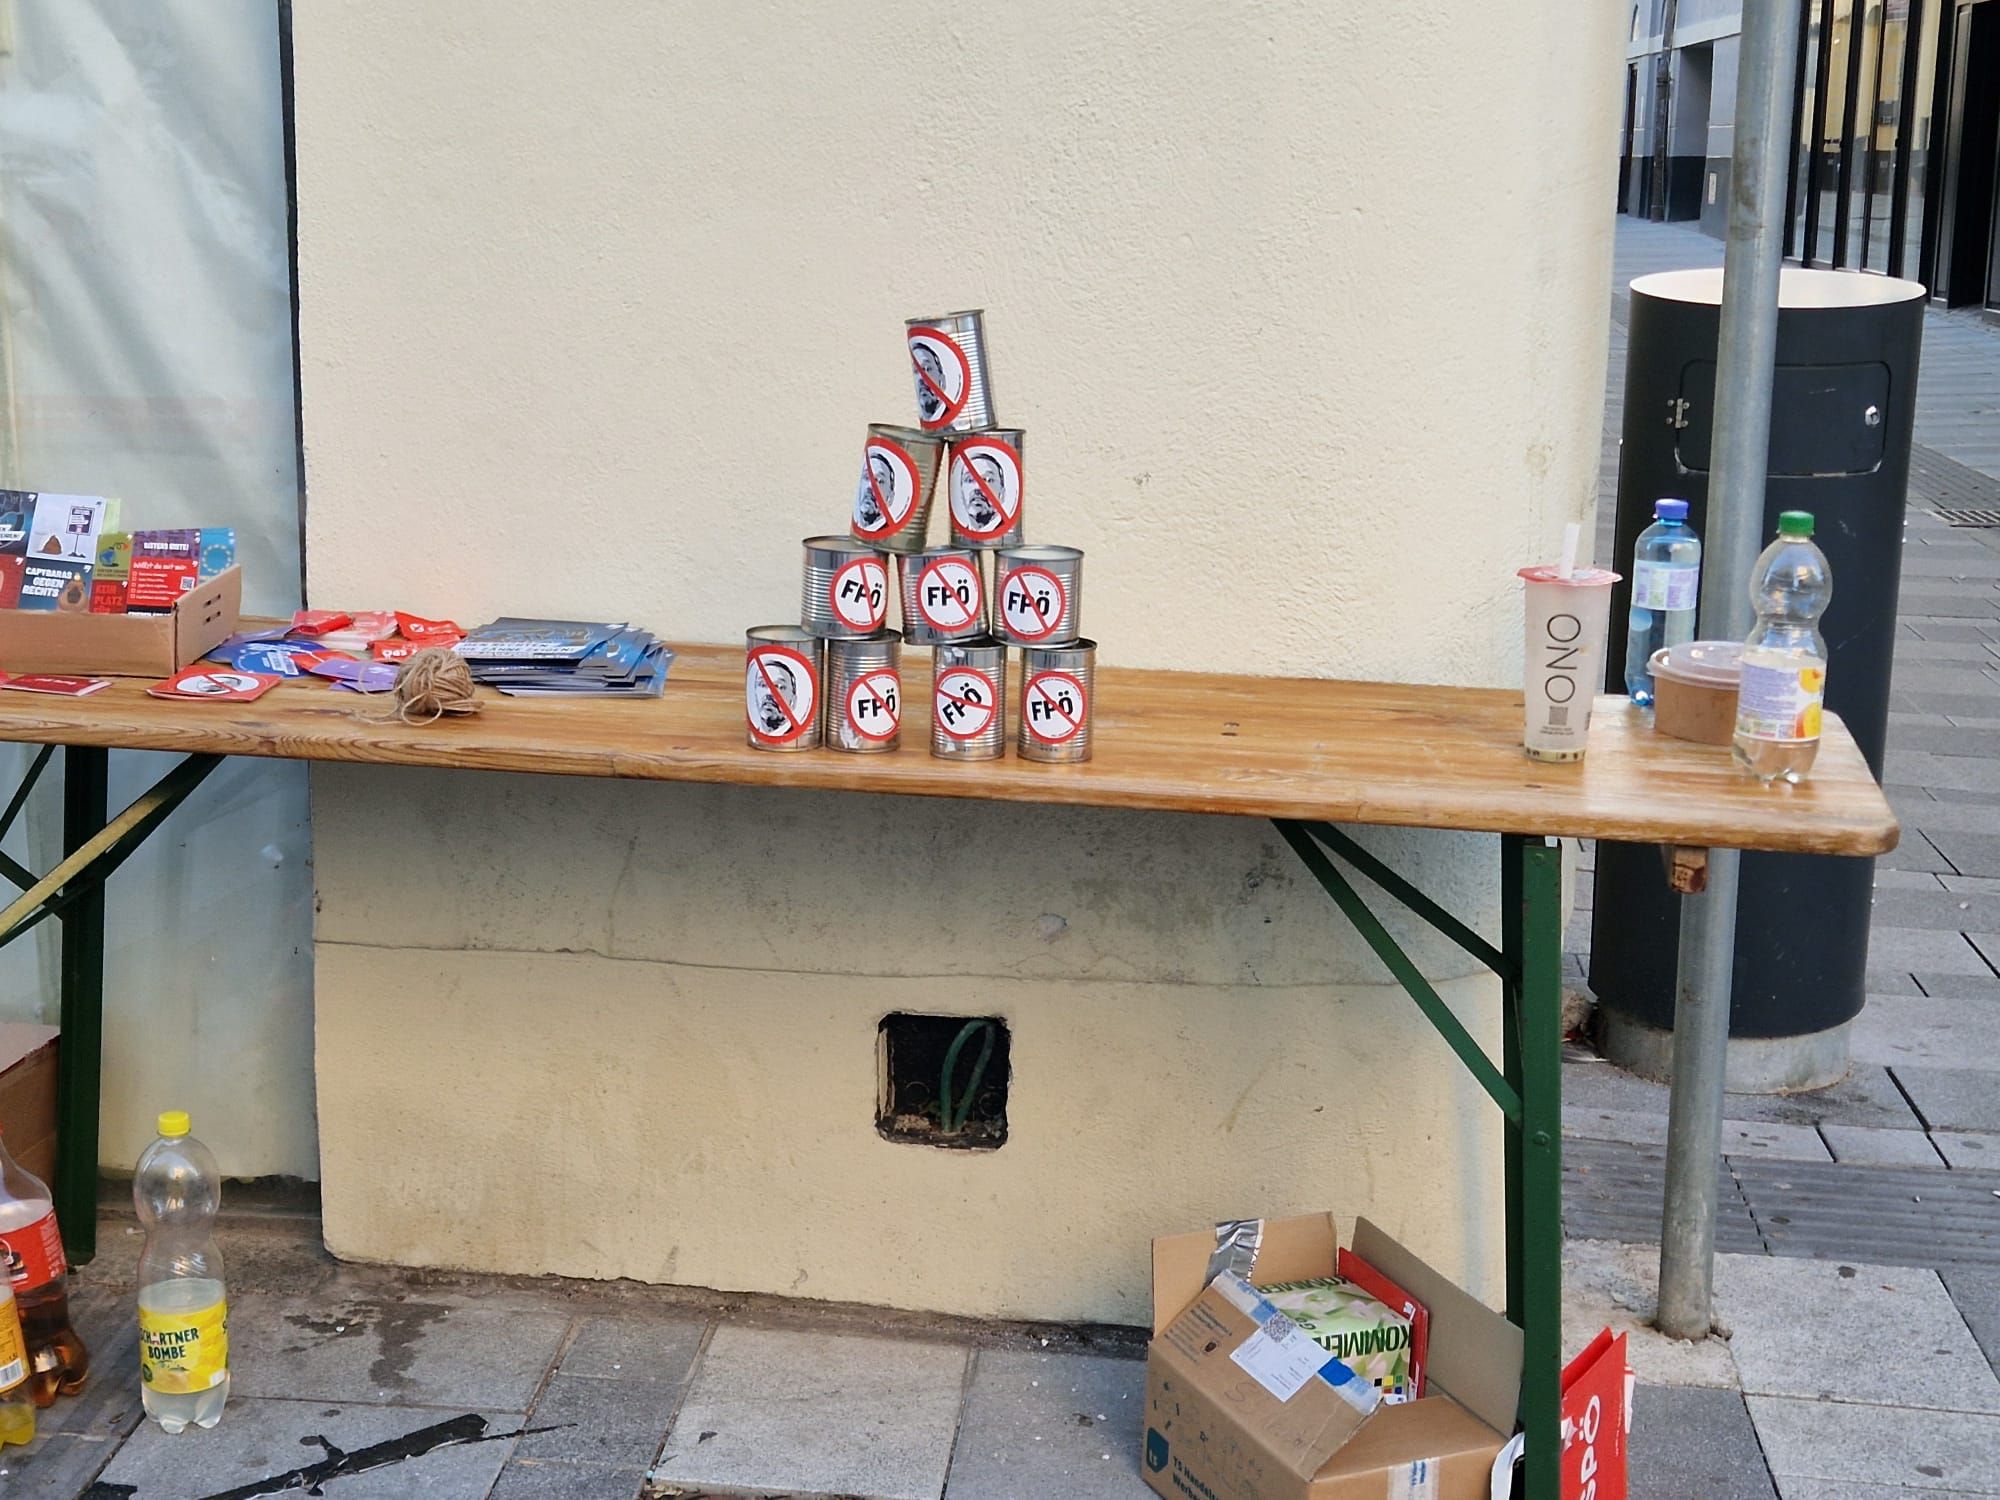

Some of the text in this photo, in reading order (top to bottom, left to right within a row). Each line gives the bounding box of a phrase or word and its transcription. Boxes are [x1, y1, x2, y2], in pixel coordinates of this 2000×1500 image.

[26, 567, 73, 580] CAPYBARAS
[33, 577, 65, 589] GEGEN
[22, 585, 60, 598] RECHTS
[94, 595, 123, 606] PLATZ
[841, 579, 883, 608] FPÖ
[928, 579, 970, 607] FPÖ
[1008, 590, 1050, 616] FPÖ
[1545, 614, 1582, 704] ONO
[858, 687, 896, 718] FPÖ
[942, 682, 982, 725] FPÖ
[1031, 690, 1074, 721] FPÖ
[148, 1346, 187, 1360] BOMBE
